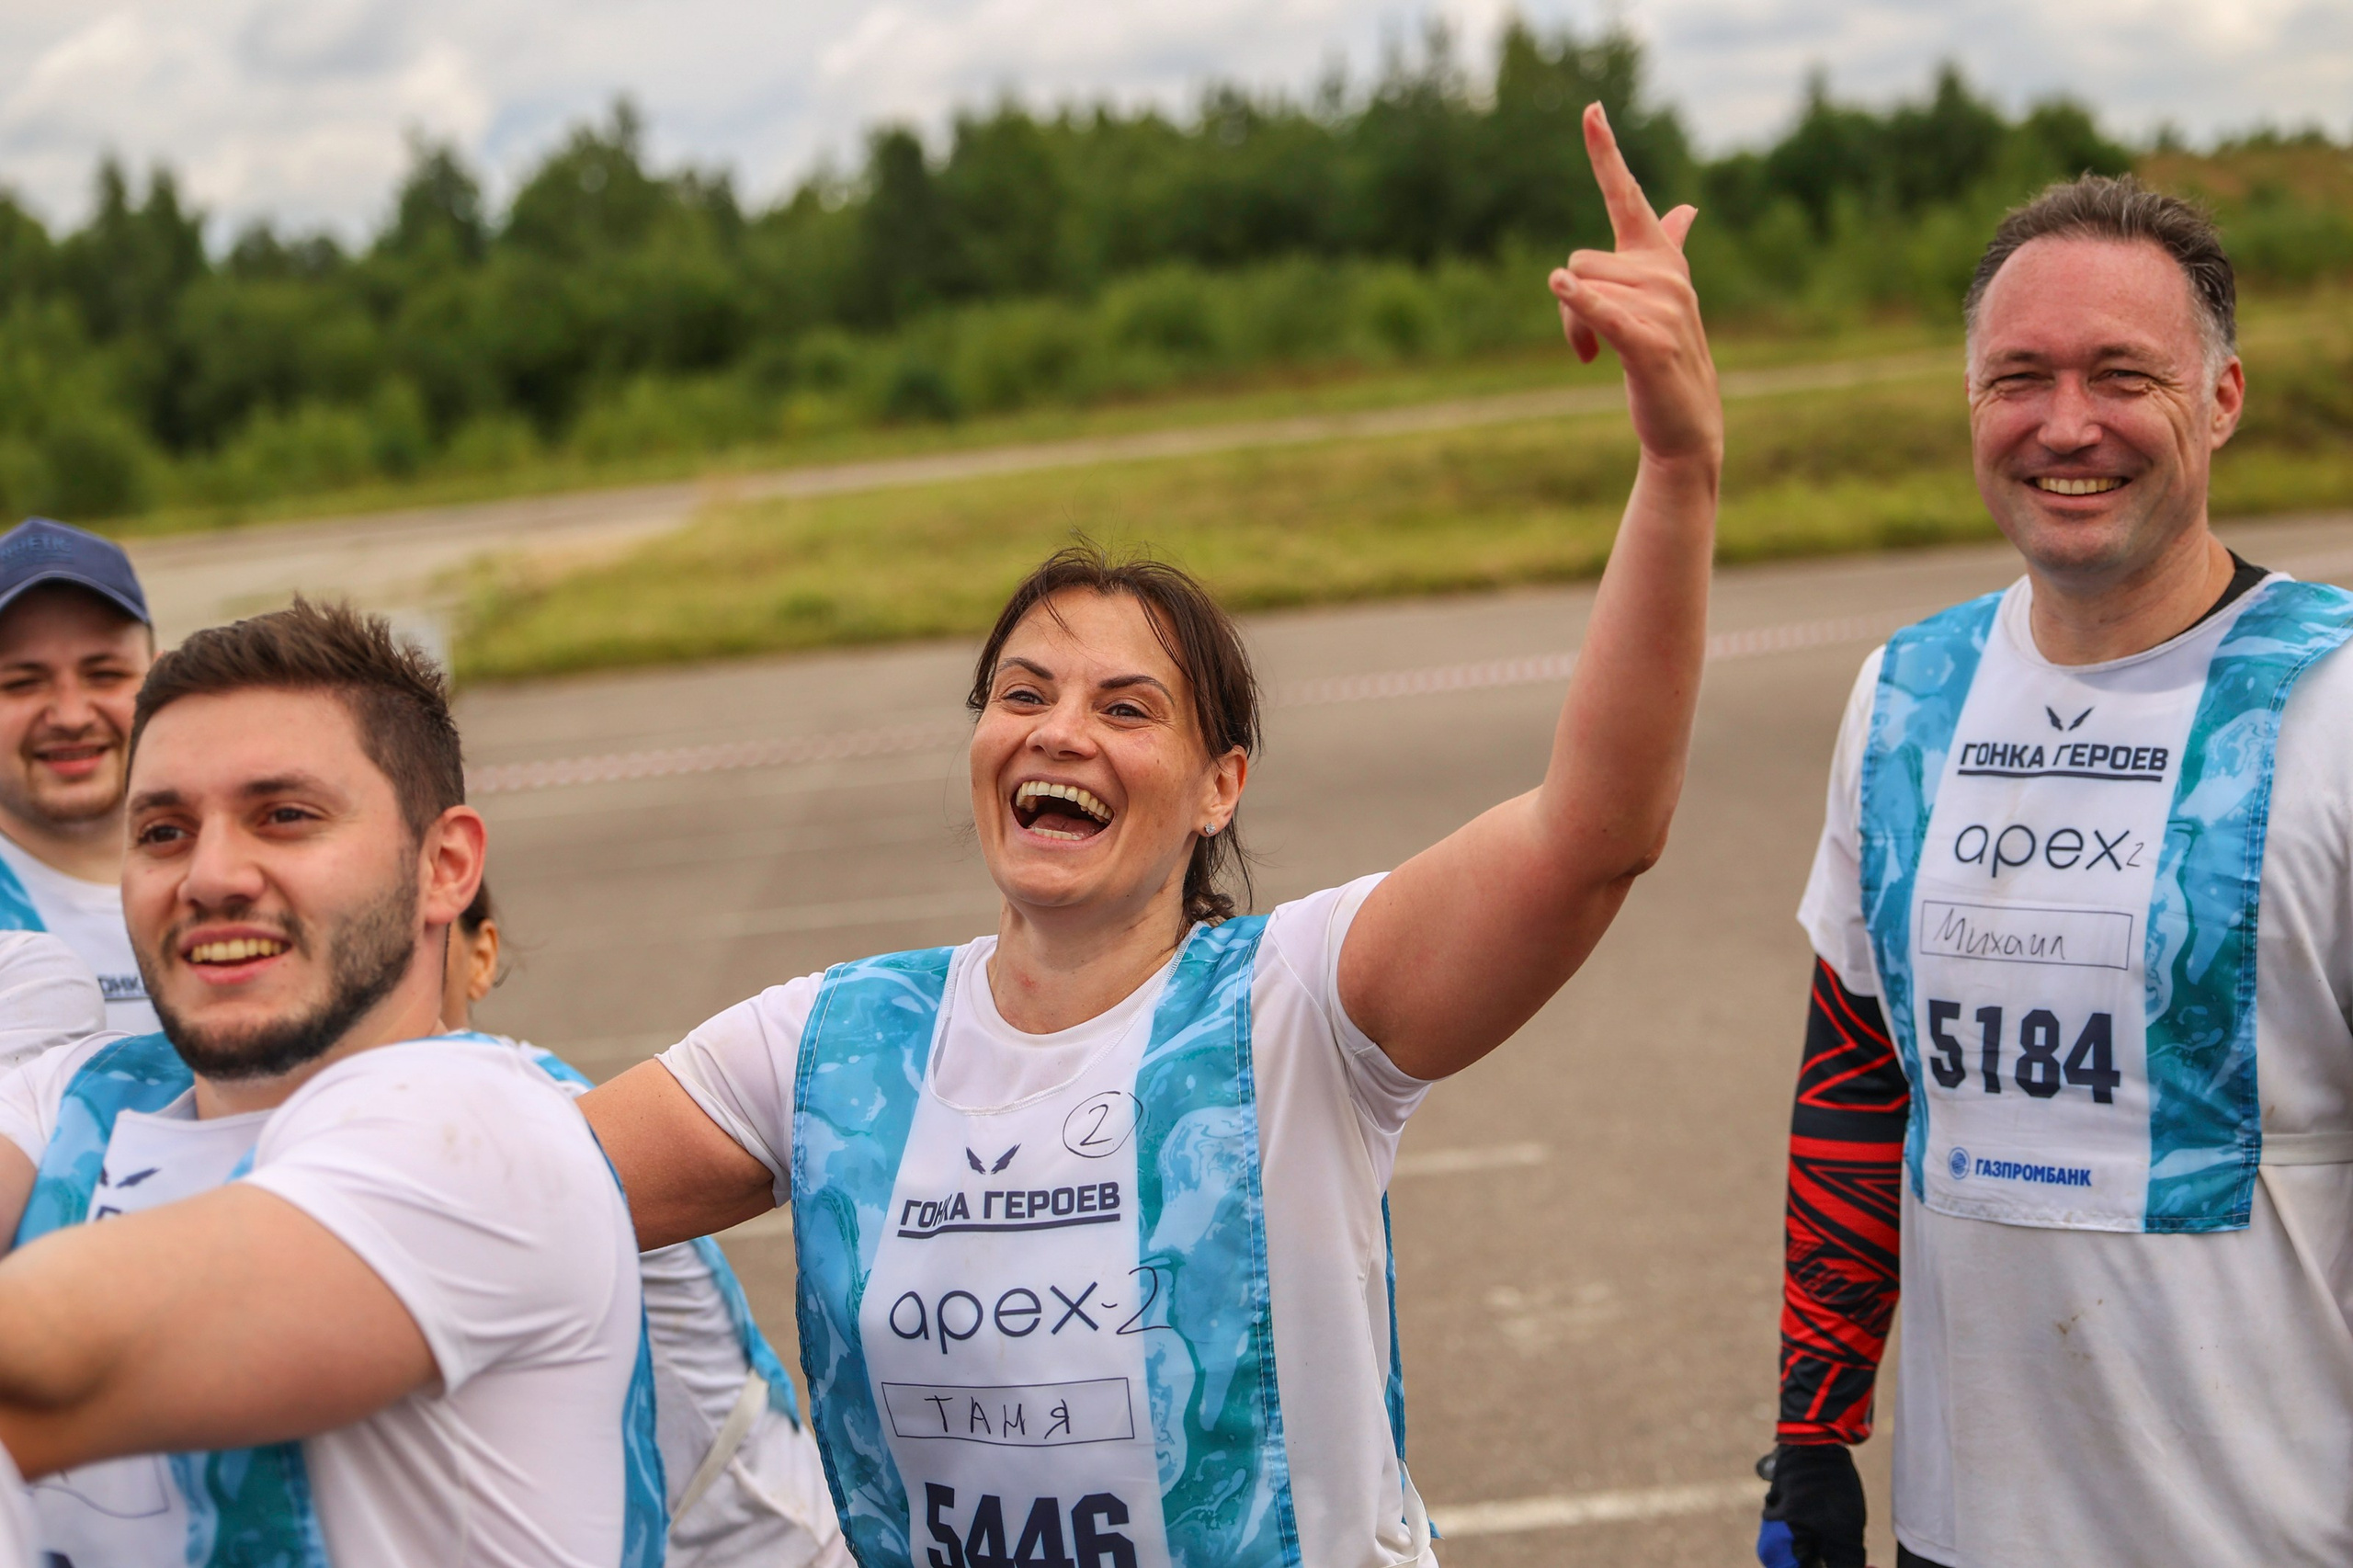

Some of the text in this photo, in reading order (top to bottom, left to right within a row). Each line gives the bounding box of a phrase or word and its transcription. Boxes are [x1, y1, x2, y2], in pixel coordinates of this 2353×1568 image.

[1960, 742, 2169, 771] ГОНКА ГЕРОЕВ
[1934, 907, 2067, 960] Михаил
[1928, 998, 2120, 1105] 5184
[1079, 1103, 1115, 1146] 2
[1974, 1158, 2092, 1187] ГАЗПРОМБАНК
[899, 1181, 1121, 1228] ГОНКА ГЕРОЕВ
[924, 1482, 1138, 1568] 5446
